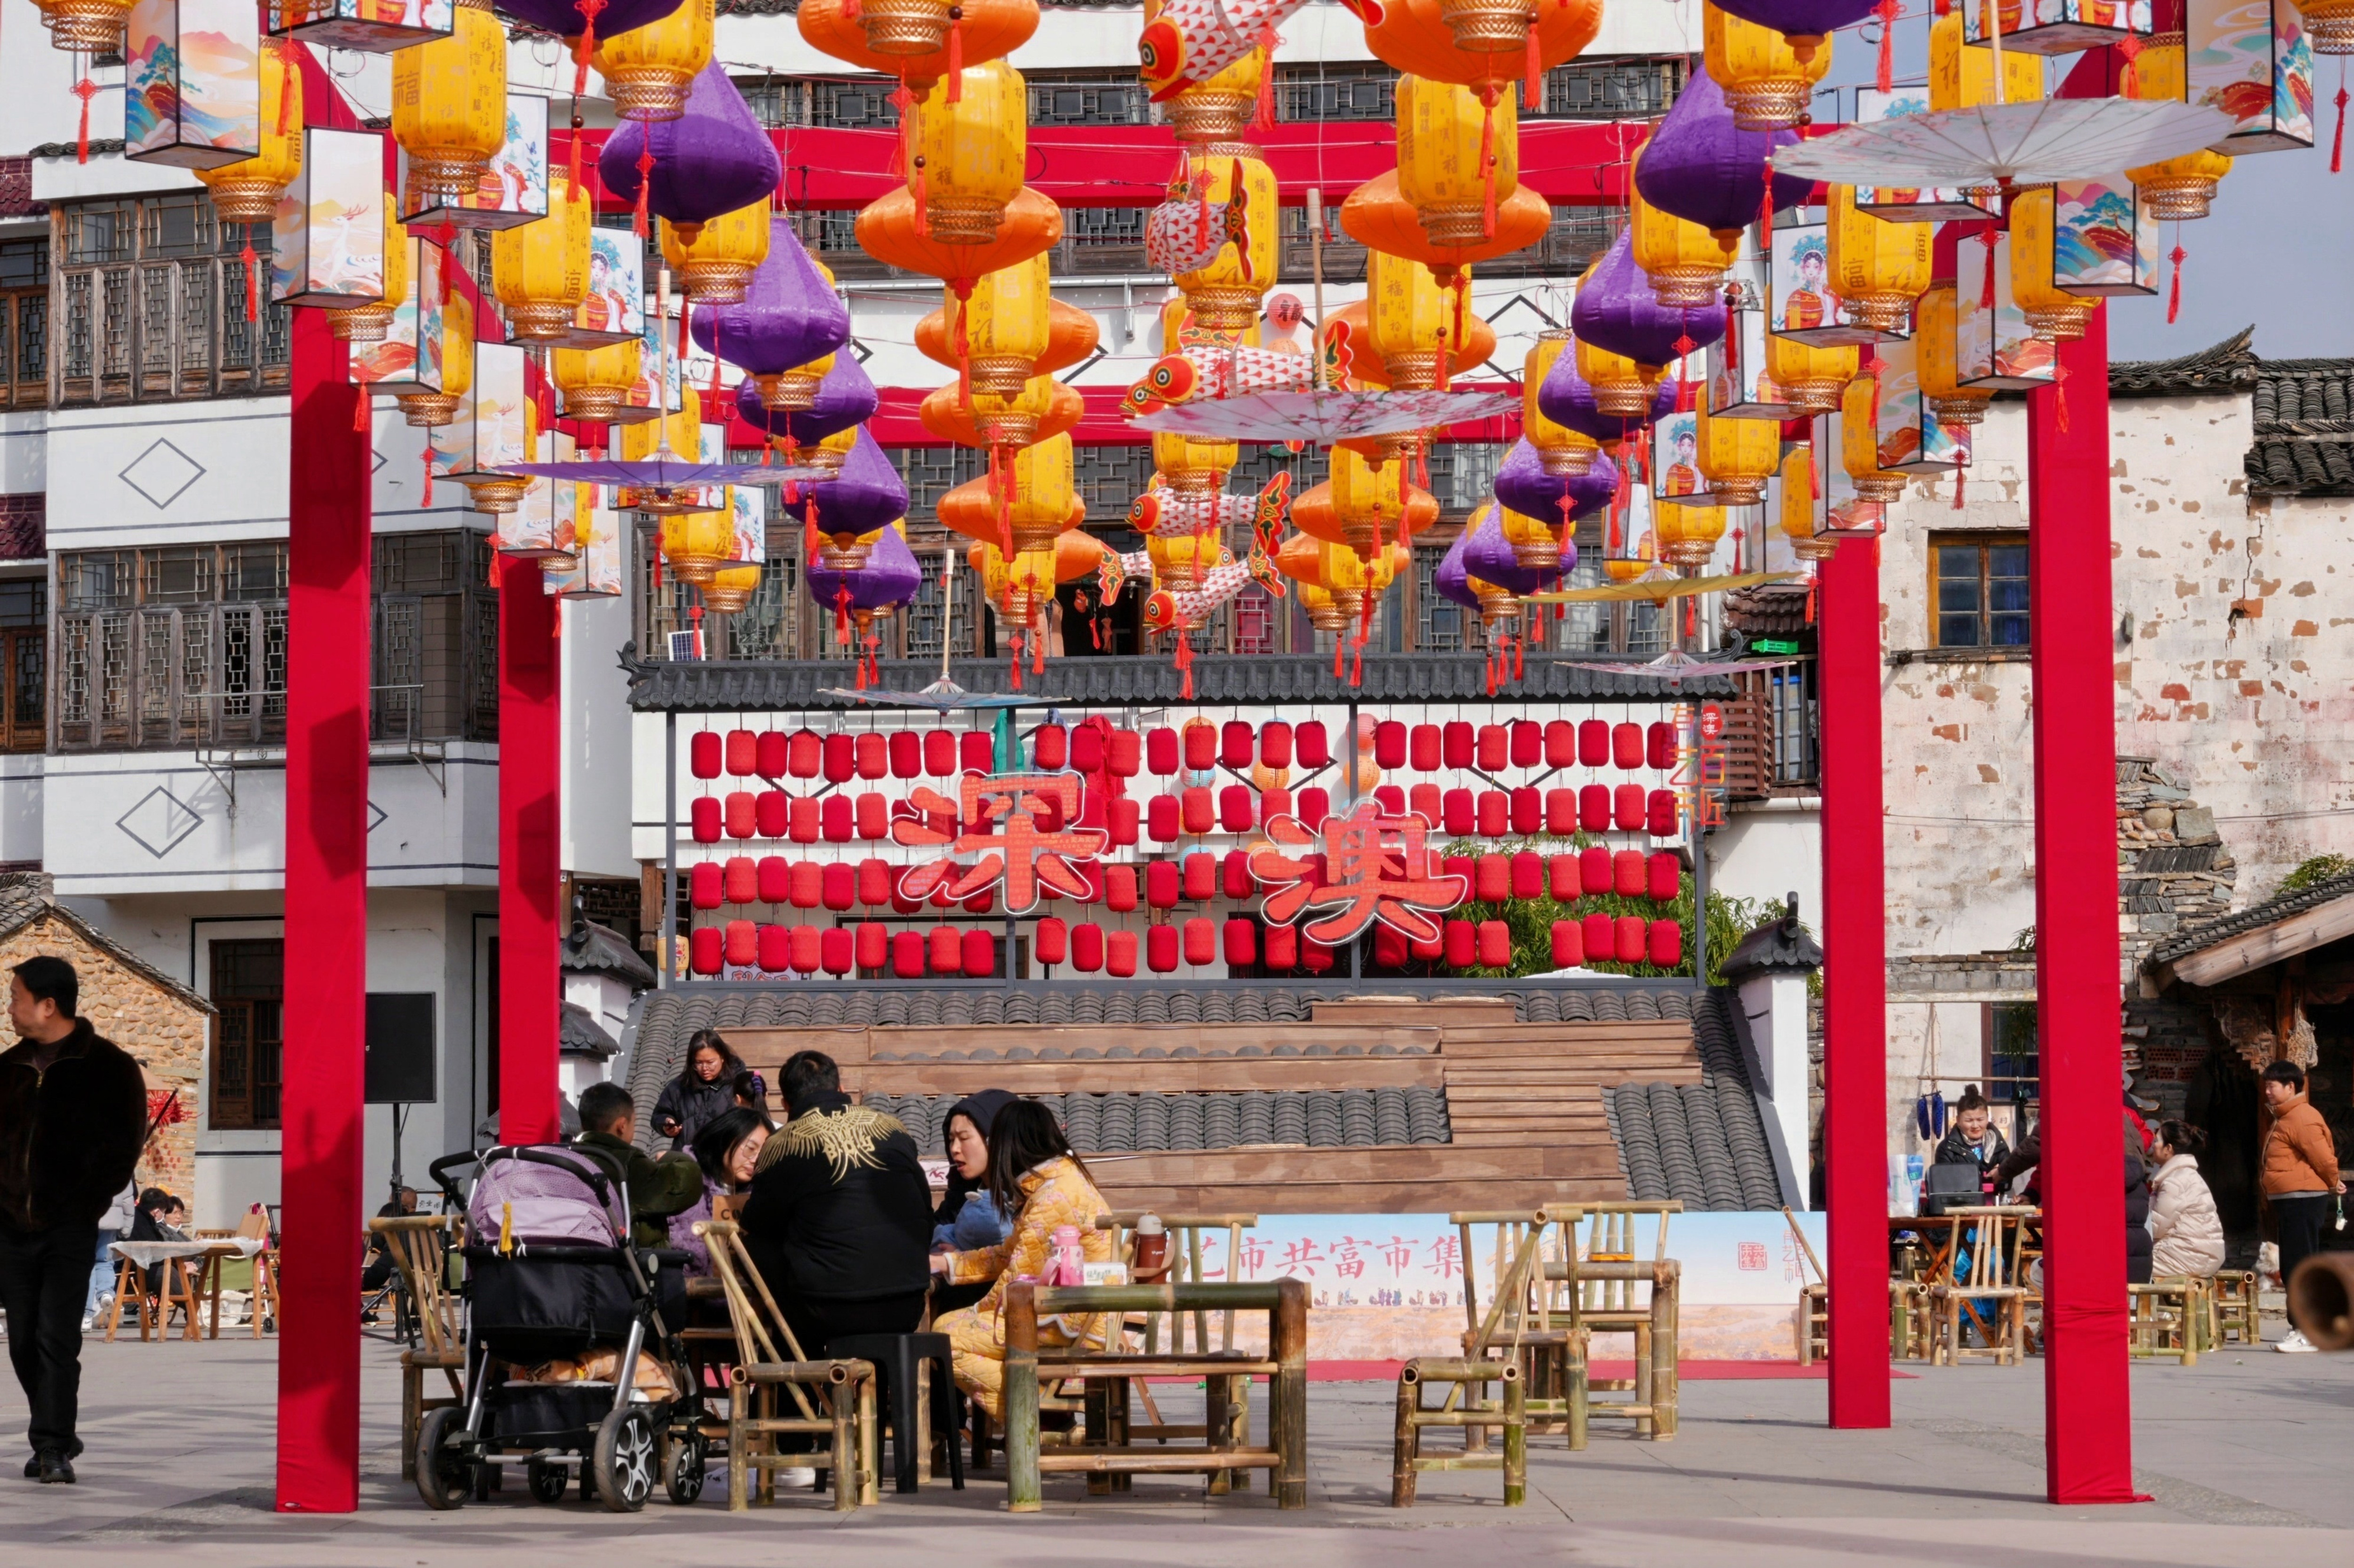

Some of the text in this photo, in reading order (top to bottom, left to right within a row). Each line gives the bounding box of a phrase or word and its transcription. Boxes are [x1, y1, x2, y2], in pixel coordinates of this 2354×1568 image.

[394, 71, 419, 108] 福
[1387, 280, 1403, 297] 福
[1278, 299, 1301, 322] 福
[1703, 713, 1718, 735] 深澳
[1668, 703, 1698, 842] 有艺市
[1700, 745, 1725, 827] 百匠
